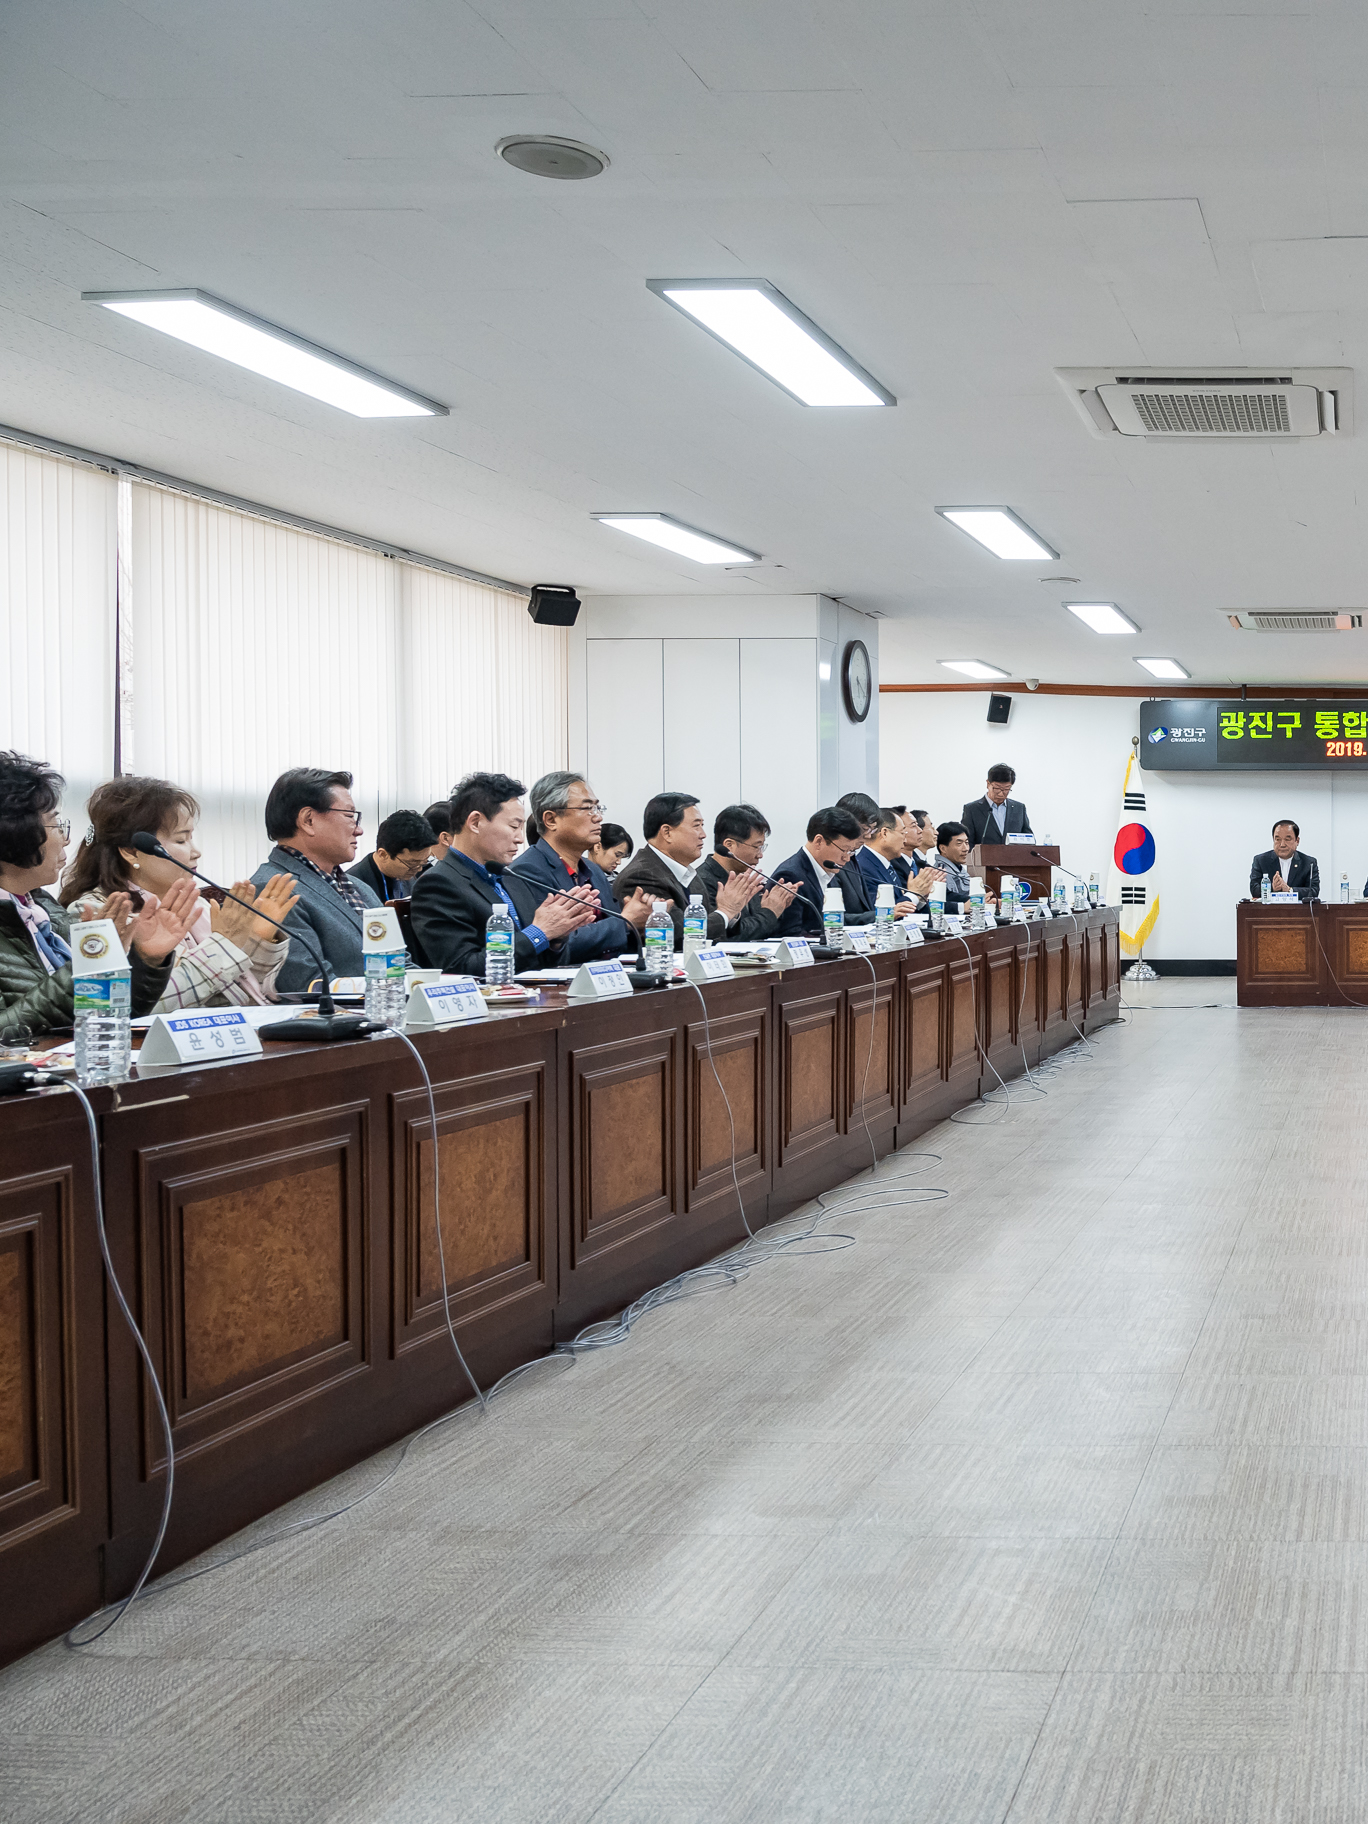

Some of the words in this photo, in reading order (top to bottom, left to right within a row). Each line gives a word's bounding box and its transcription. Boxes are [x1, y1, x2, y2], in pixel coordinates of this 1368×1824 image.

[1170, 727, 1206, 737] 광진구
[1219, 711, 1302, 740] 광진구
[1326, 742, 1367, 757] 2019.
[188, 1017, 213, 1028] KOREA
[212, 1014, 241, 1025] 대표이사
[188, 1027, 246, 1051] 윤성범
